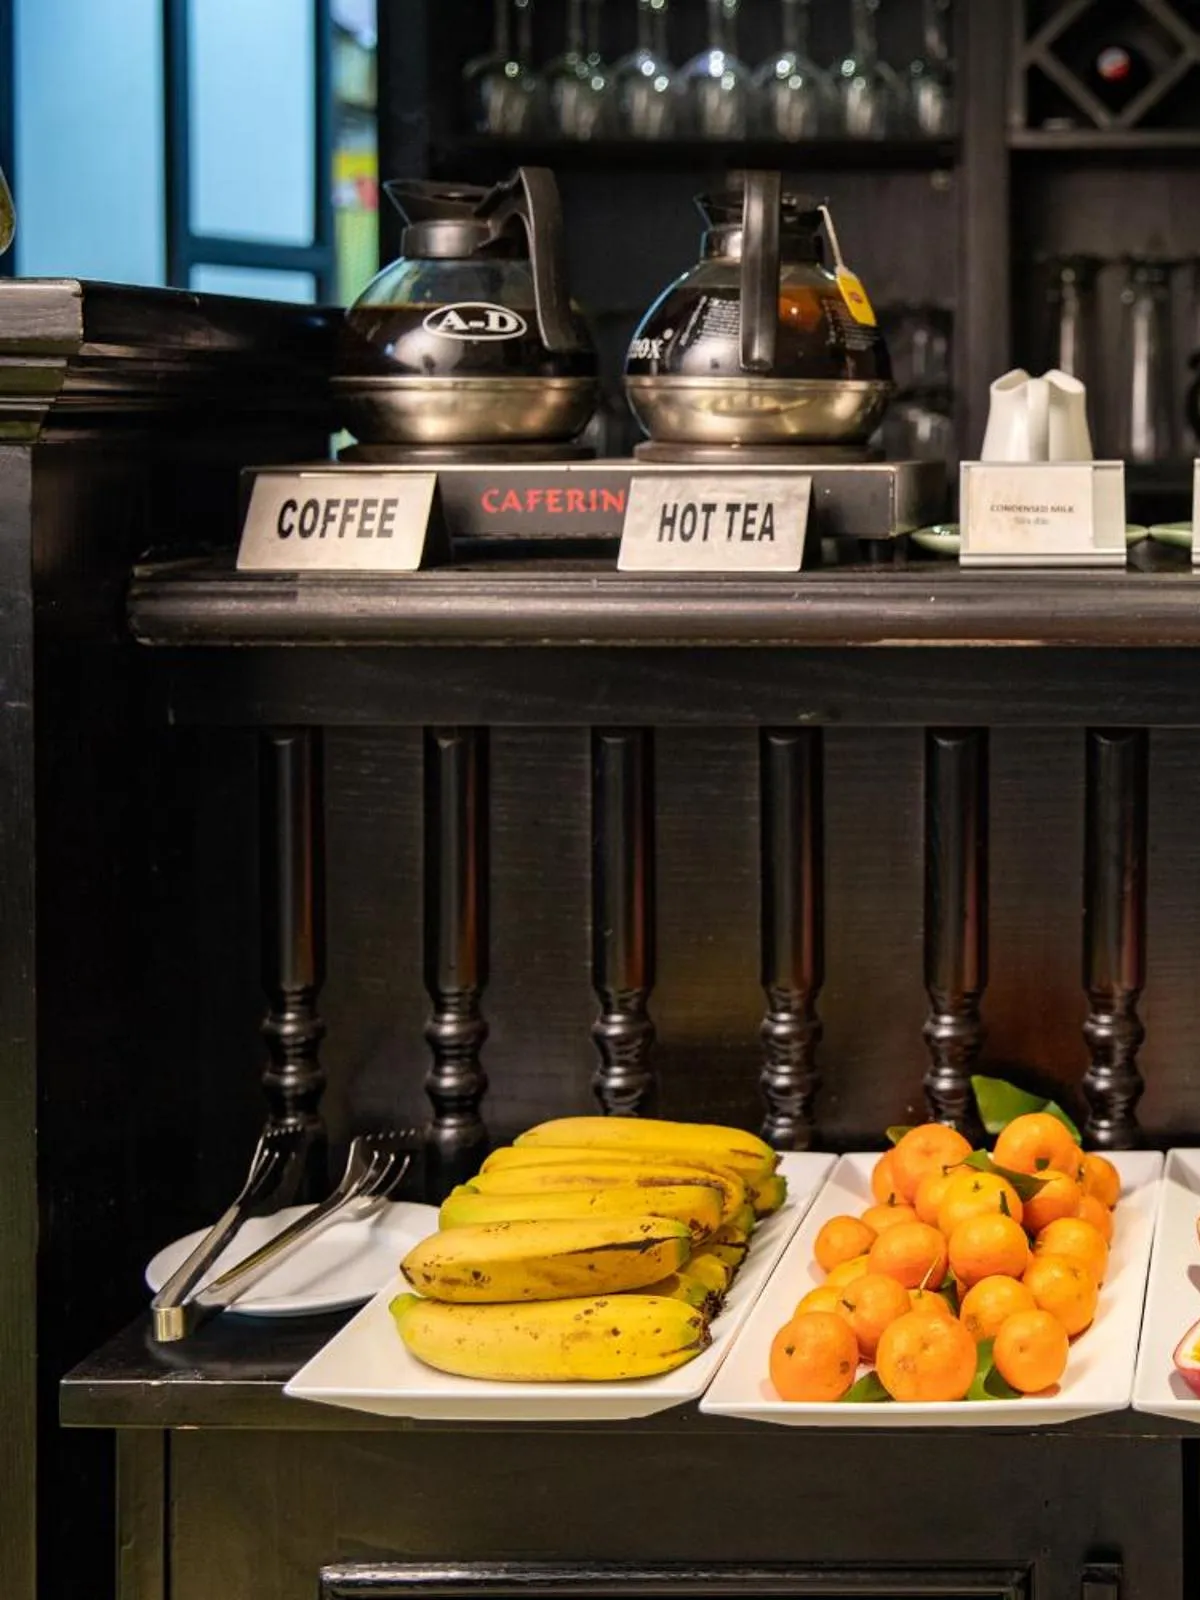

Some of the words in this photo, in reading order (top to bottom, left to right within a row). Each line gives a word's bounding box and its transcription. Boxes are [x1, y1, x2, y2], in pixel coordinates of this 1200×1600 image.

[436, 309, 519, 332] A-D
[277, 498, 399, 539] COFFEE
[657, 503, 717, 542] HOT
[725, 503, 776, 542] TEA
